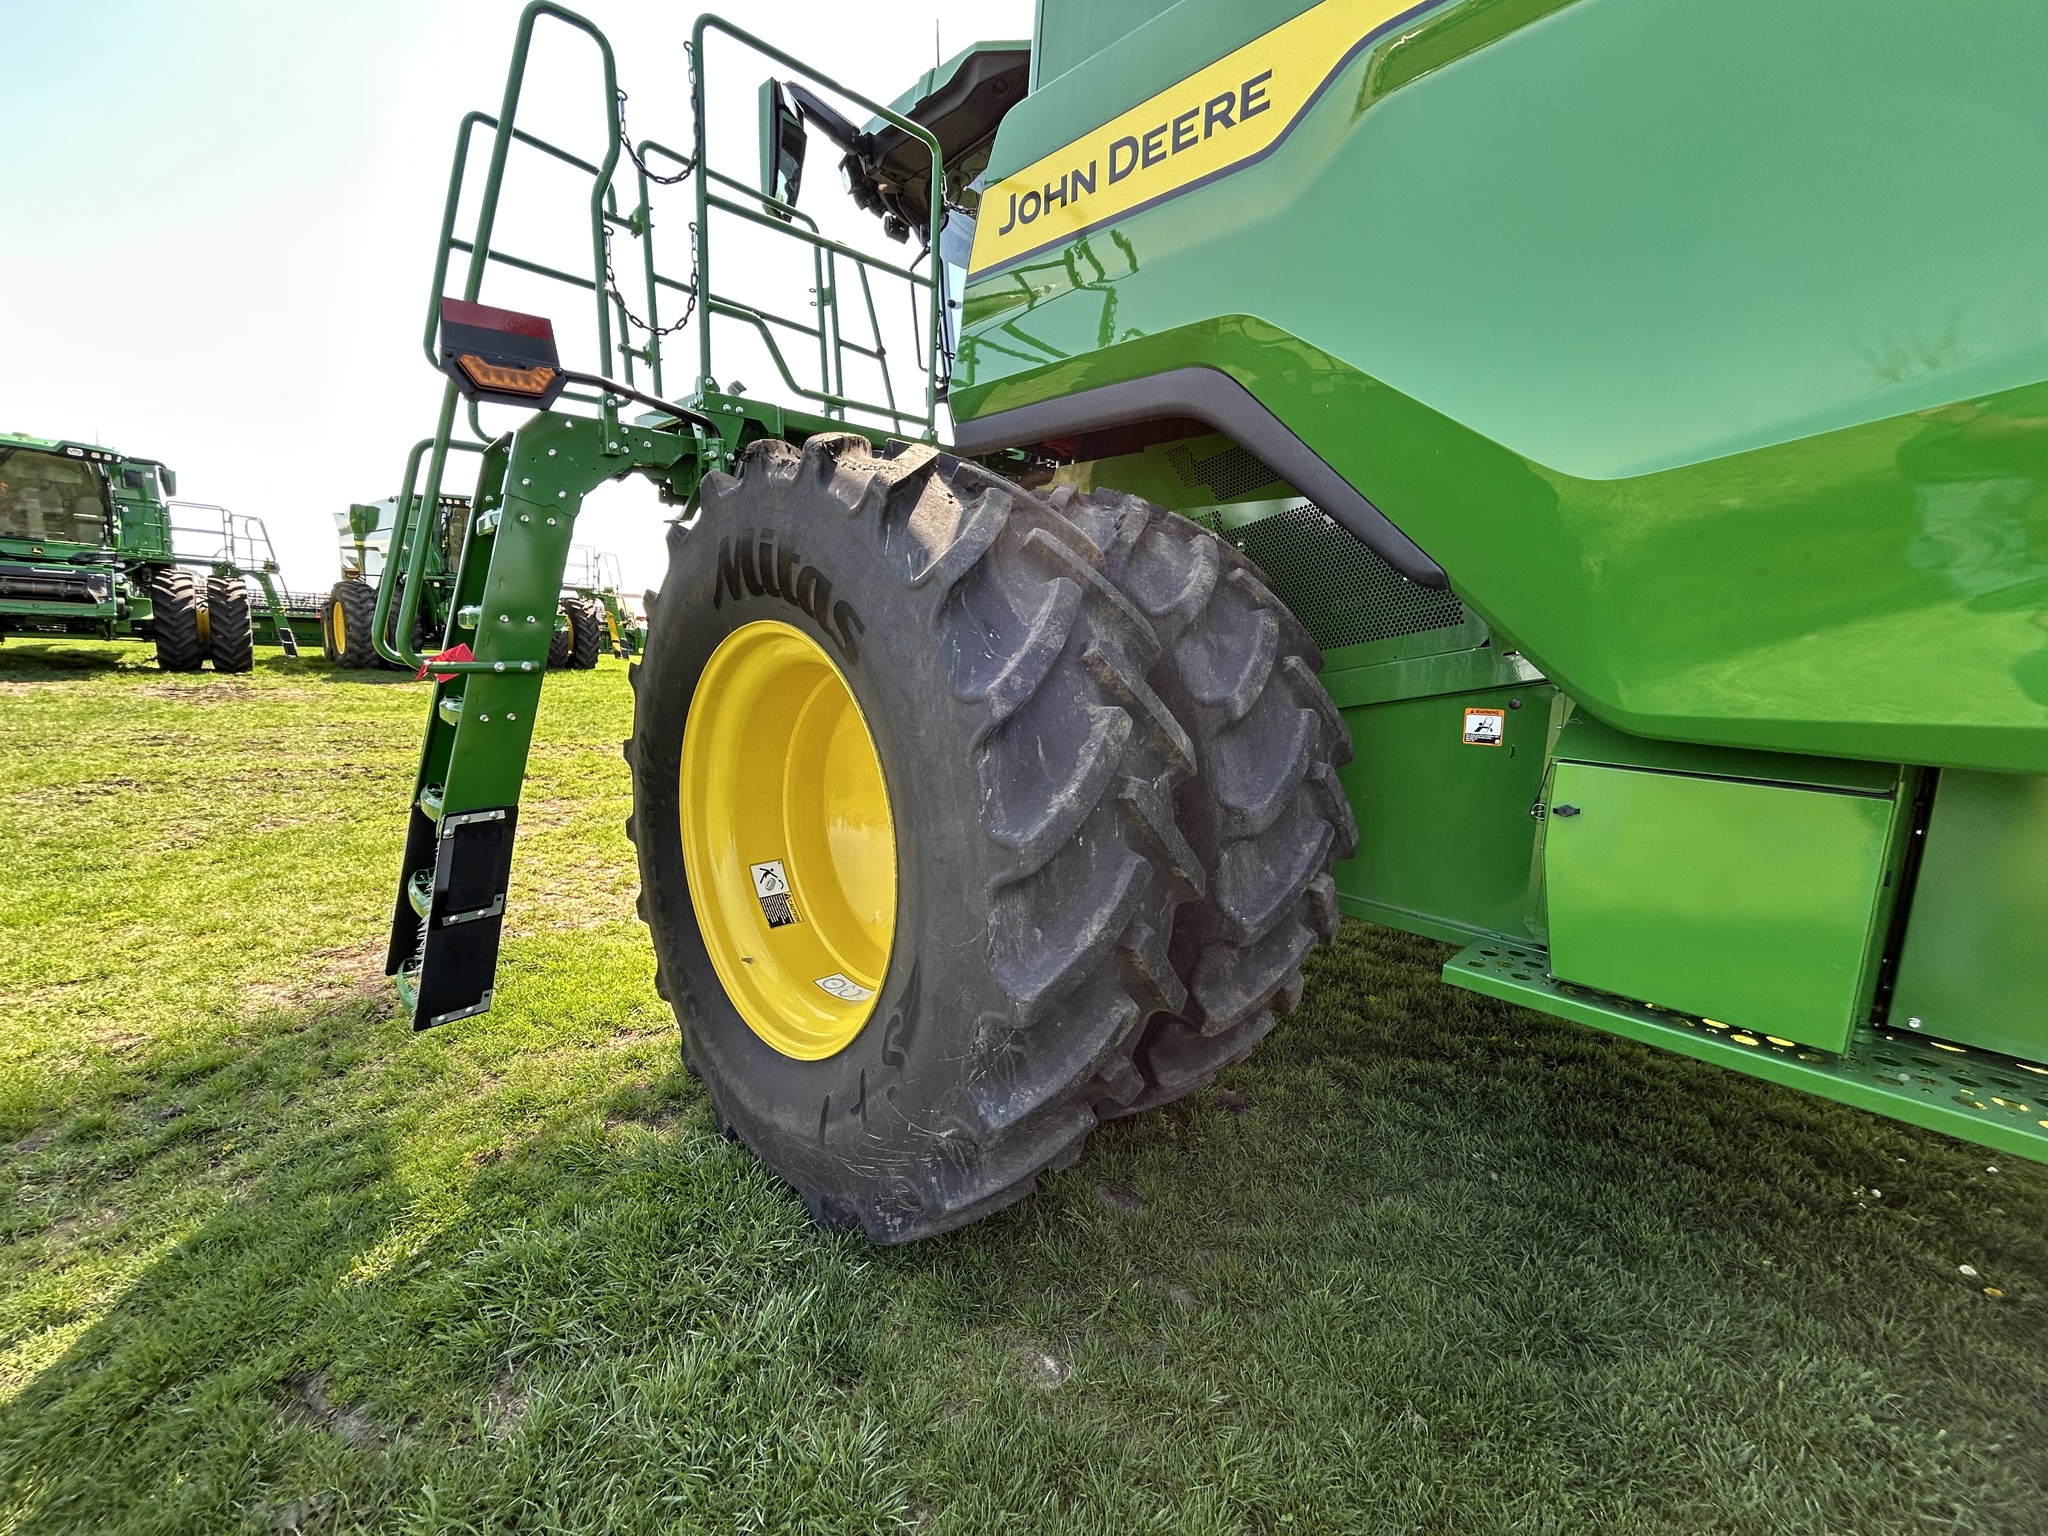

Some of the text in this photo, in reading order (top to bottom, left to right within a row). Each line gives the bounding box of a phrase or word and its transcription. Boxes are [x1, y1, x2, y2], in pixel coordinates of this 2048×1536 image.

[998, 68, 1273, 237] JOHN DEERE
[712, 527, 866, 668] Mitas
[787, 899, 801, 922] CAUTION
